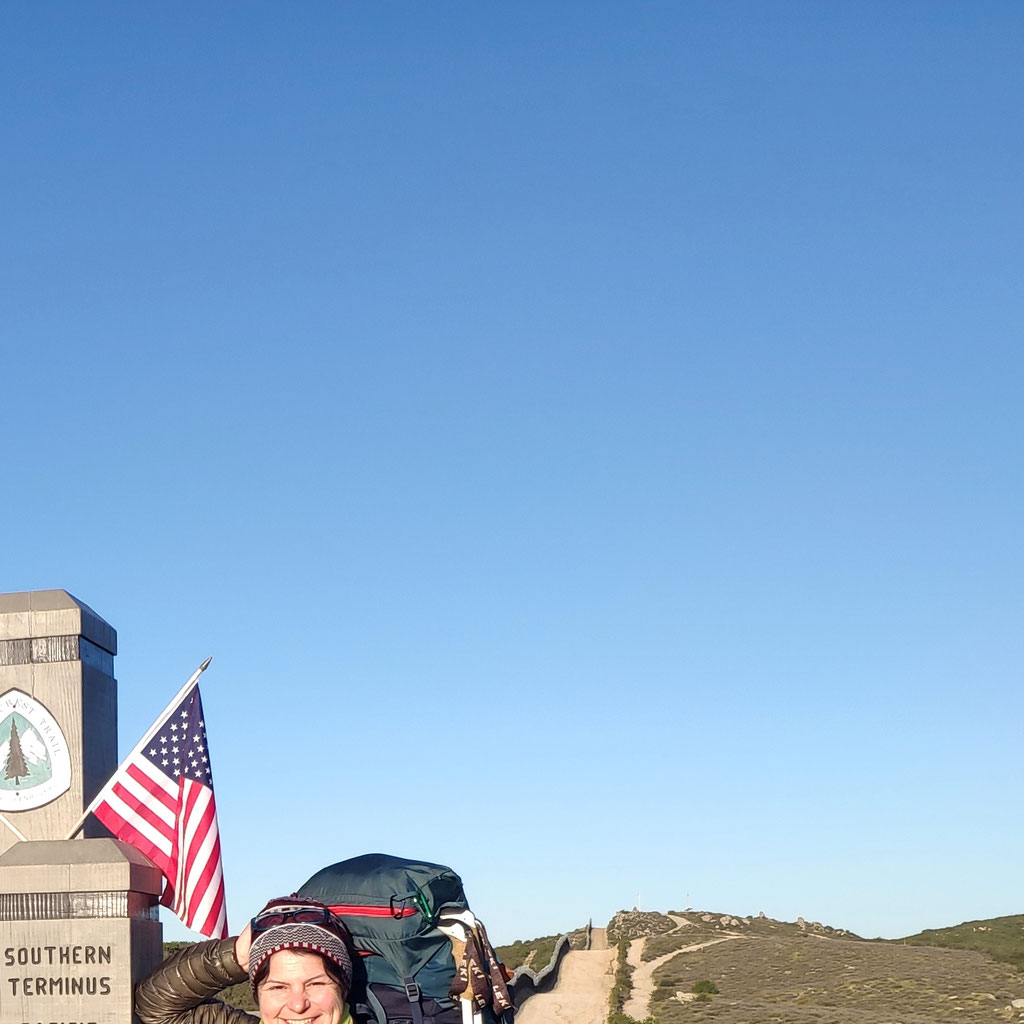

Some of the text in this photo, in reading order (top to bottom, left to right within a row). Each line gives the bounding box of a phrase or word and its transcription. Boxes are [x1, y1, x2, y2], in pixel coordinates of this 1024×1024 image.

[39, 717, 61, 756] TRAIL
[4, 945, 112, 967] SOUTHERN
[8, 976, 112, 996] TERMINUS
[492, 985, 511, 1009] LEKI
